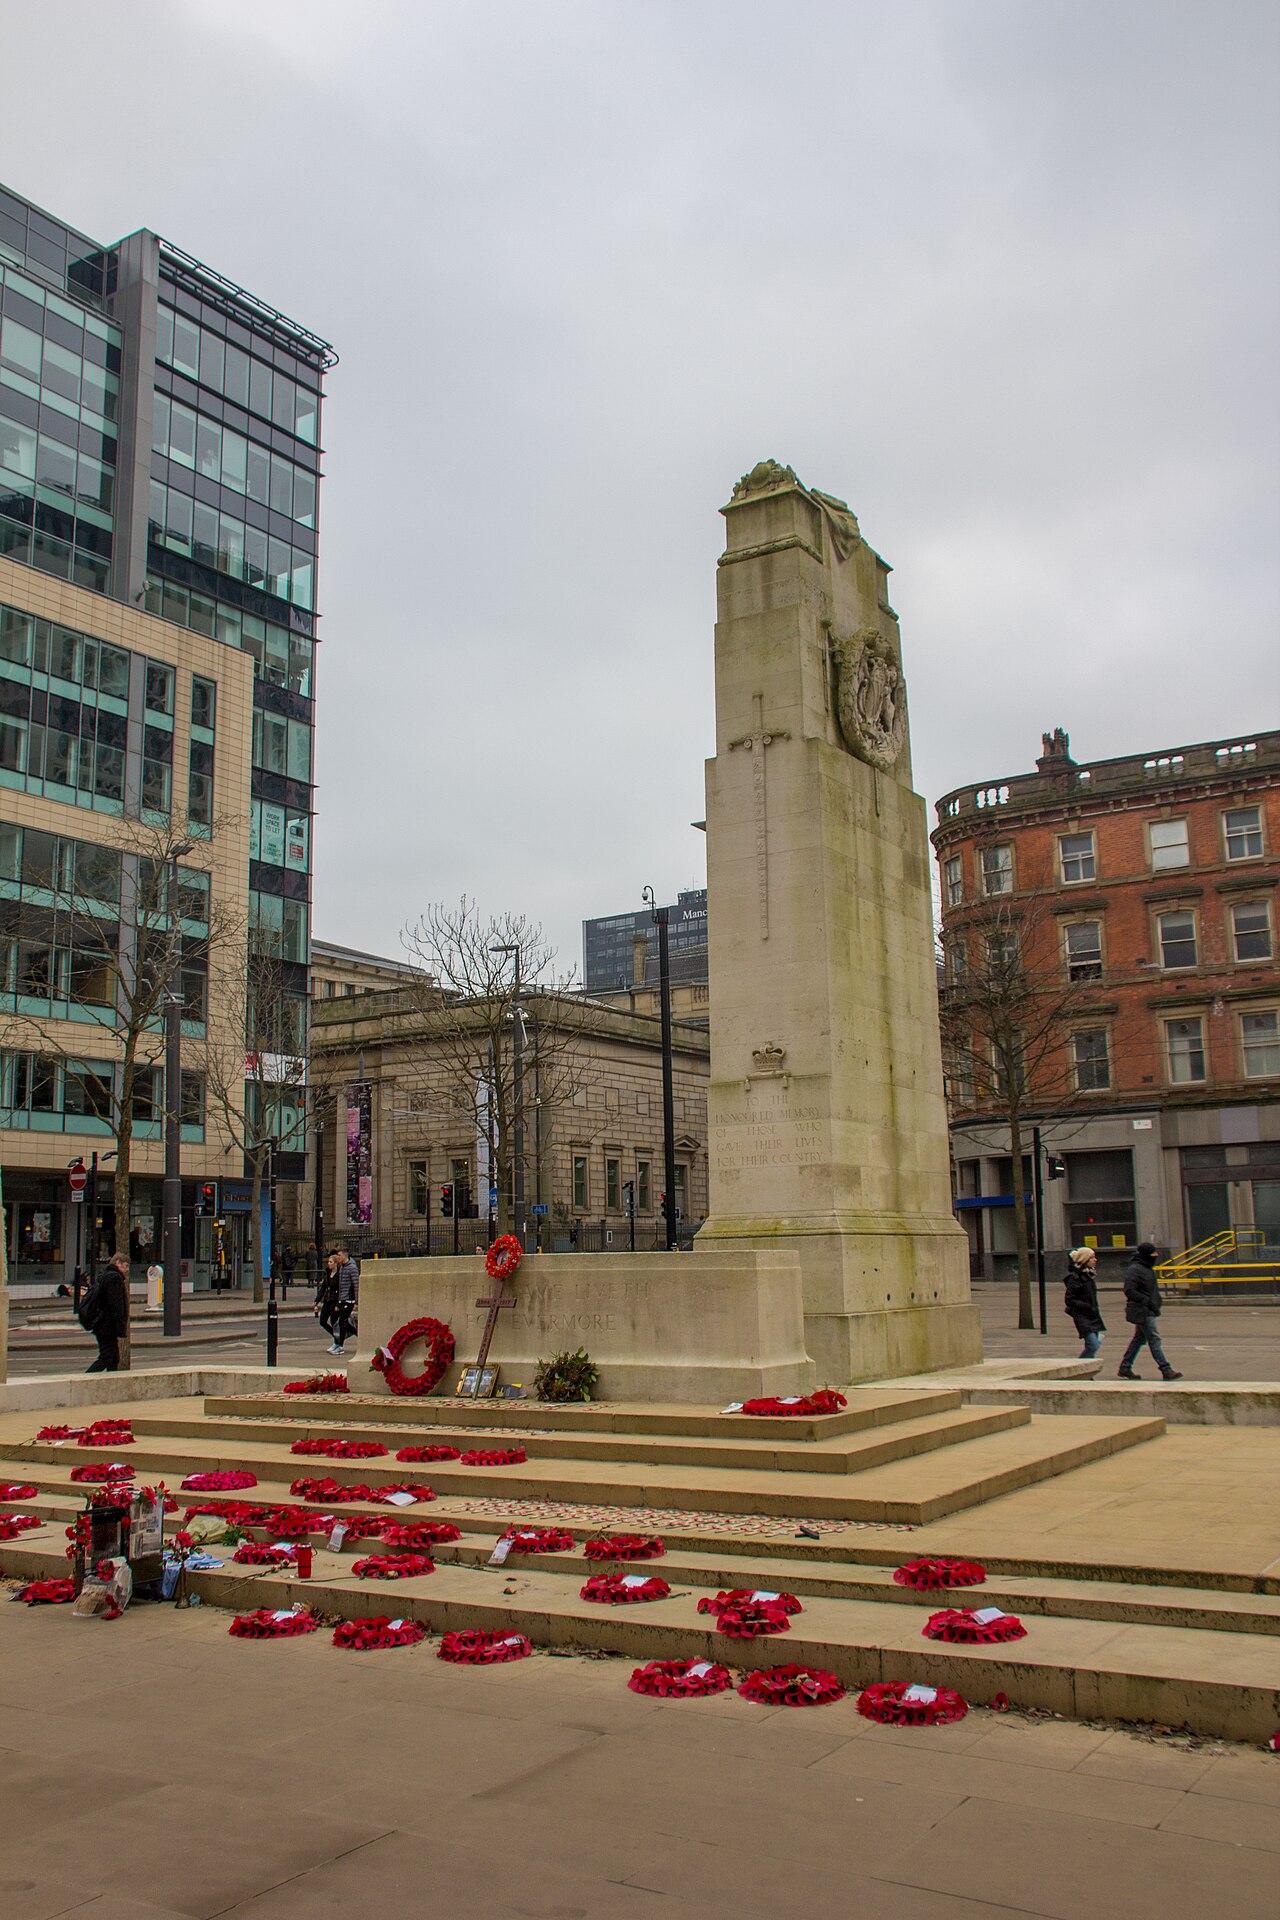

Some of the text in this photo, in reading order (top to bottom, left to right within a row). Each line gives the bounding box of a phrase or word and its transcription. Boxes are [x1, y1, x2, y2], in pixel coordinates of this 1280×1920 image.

[266, 812, 280, 820] WORK
[266, 819, 279, 827] SPACE
[745, 1094, 789, 1107] TO THE
[715, 1106, 820, 1124] HONOURED MEMORY
[715, 1121, 823, 1138] OF THOSE WHO
[716, 1137, 823, 1152] GAVE THEIR LIVES
[717, 1157, 736, 1167] FOR
[741, 1155, 769, 1166] THEIR
[575, 1281, 649, 1300] LIVETH
[511, 1313, 617, 1331] EVERMORE
